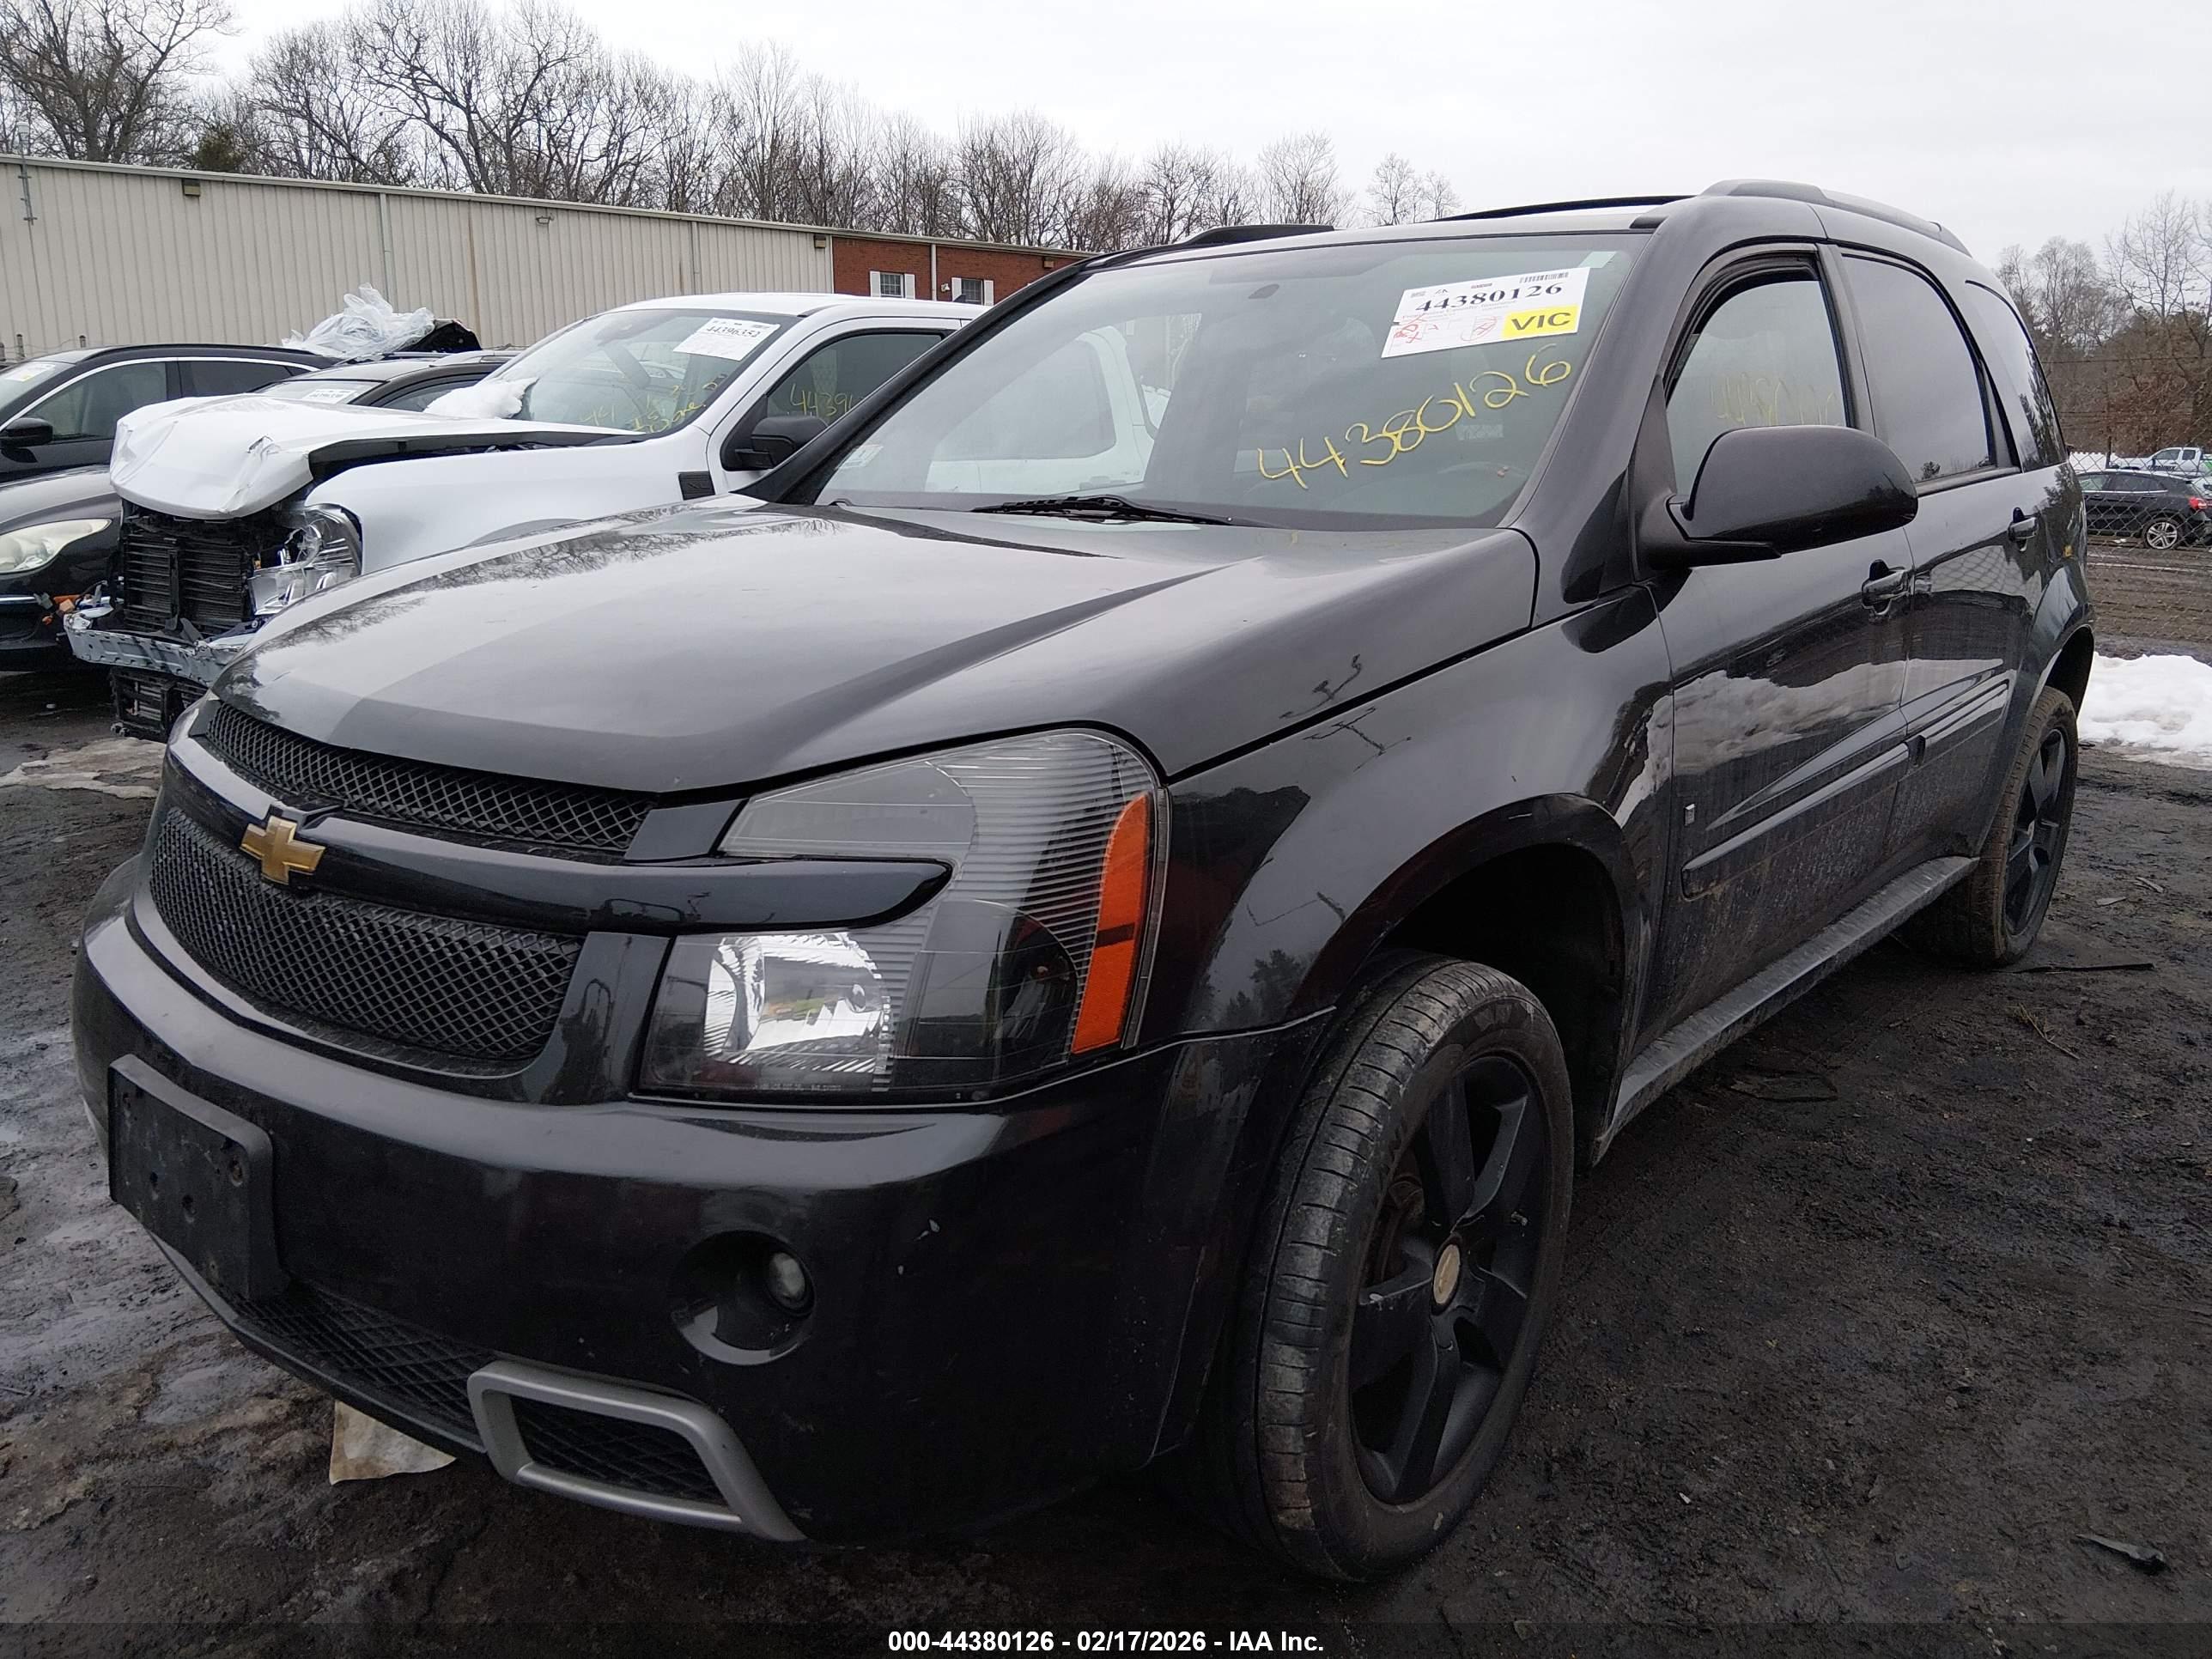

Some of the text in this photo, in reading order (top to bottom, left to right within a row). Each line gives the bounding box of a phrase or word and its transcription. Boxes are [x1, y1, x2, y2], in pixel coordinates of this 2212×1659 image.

[1415, 283, 1564, 312] 44380126
[1511, 312, 1571, 331] VIC
[1257, 343, 1572, 490] 44380126
